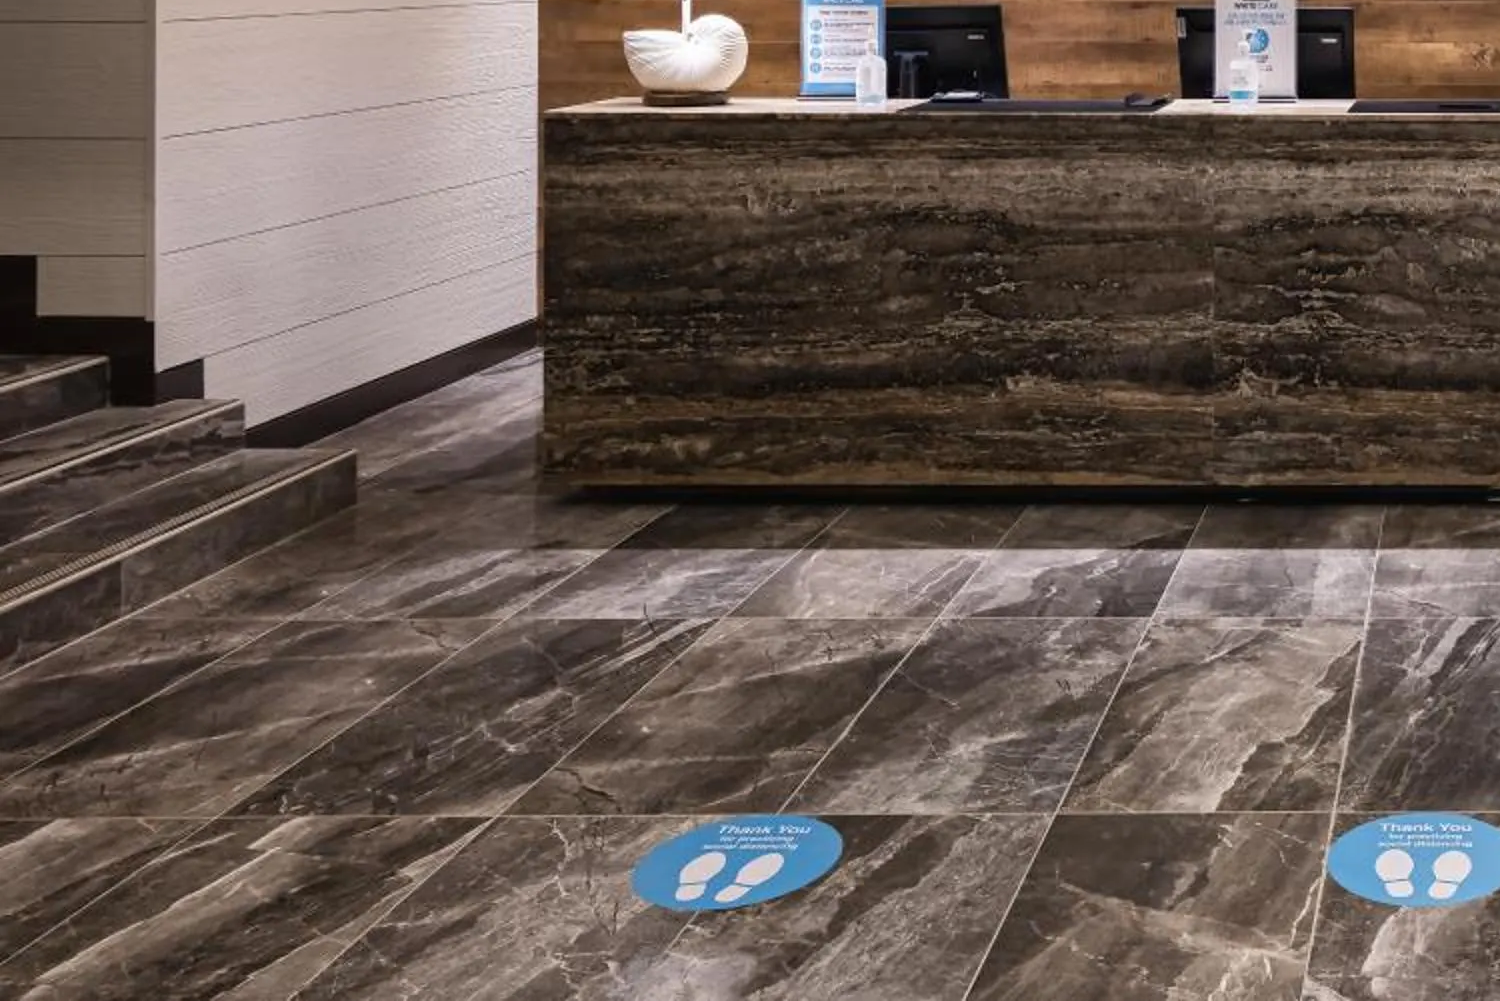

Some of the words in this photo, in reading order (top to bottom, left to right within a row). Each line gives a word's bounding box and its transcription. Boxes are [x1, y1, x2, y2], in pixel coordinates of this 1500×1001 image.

[719, 825, 772, 835] Thank
[778, 825, 812, 835] You
[1380, 823, 1434, 832] Thank
[1439, 823, 1473, 832] You
